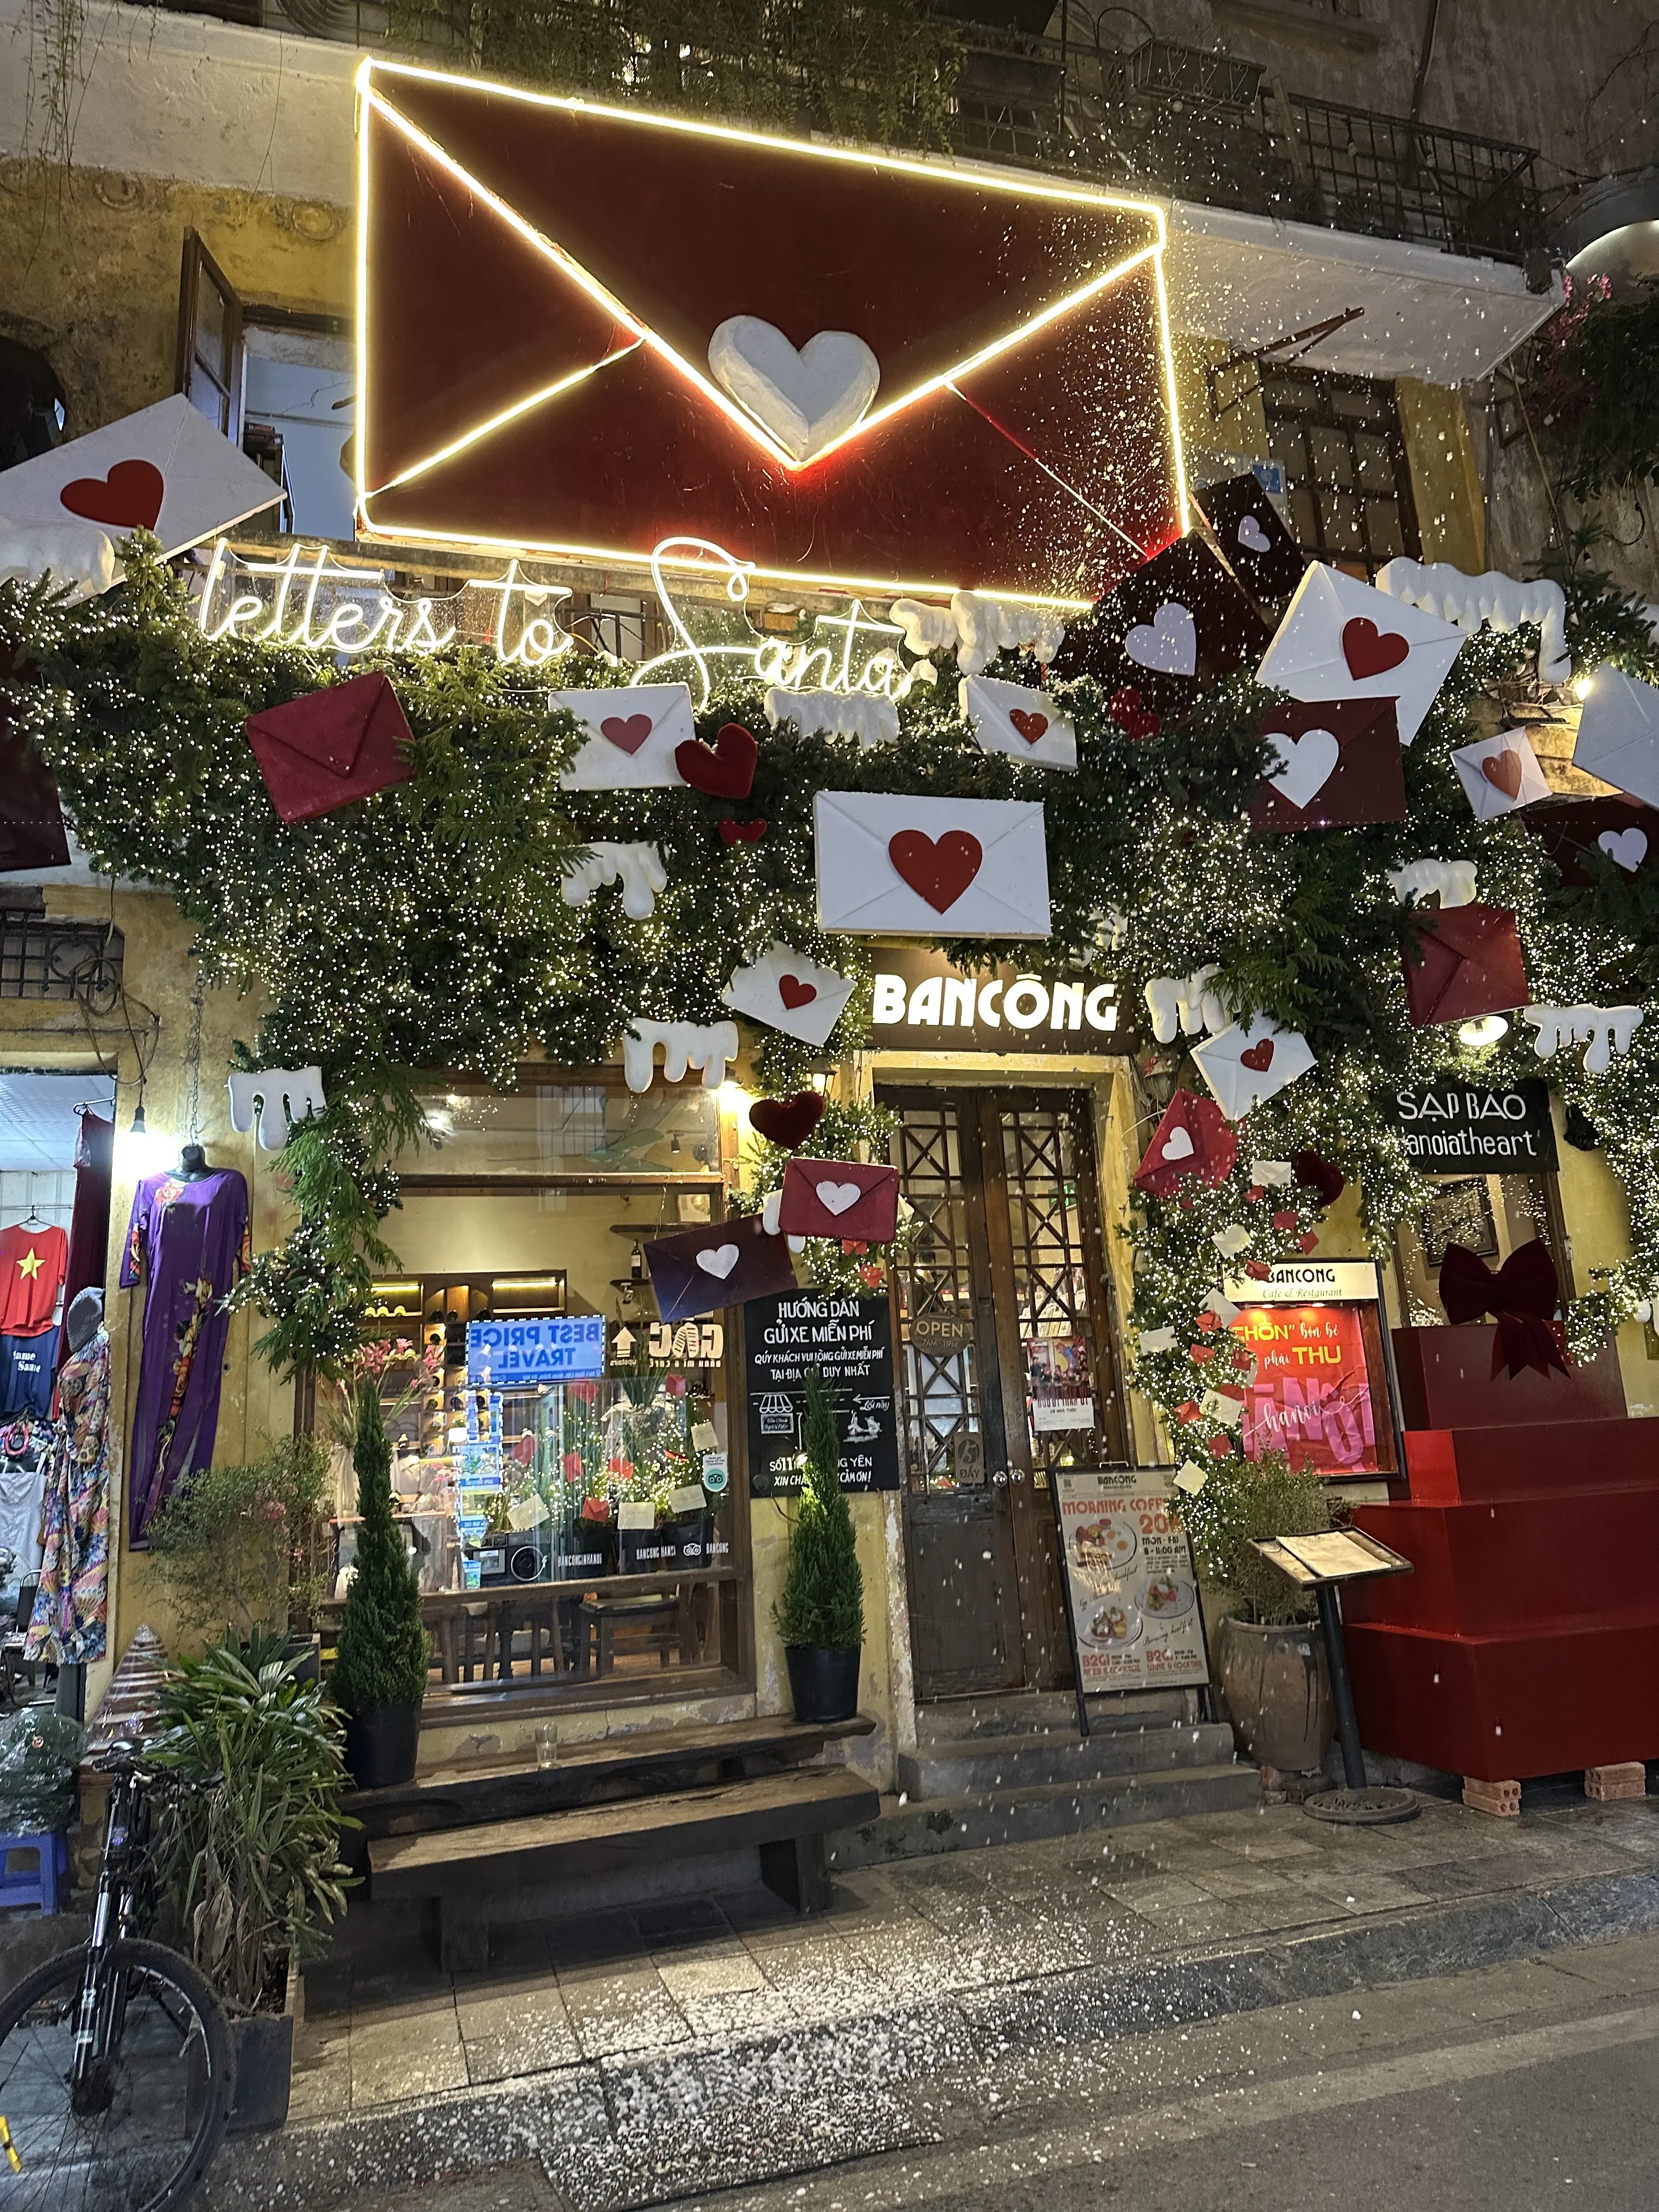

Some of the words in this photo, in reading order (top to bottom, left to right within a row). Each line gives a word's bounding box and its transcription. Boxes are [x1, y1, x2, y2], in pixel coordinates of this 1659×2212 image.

[199, 538, 455, 654] letters
[469, 558, 573, 666] to
[631, 536, 913, 712] Santa
[1466, 1092, 1526, 1120] BAO
[1296, 1288, 1343, 1299] Restaurant
[778, 1296, 828, 1318] HƯỚNG
[764, 1319, 788, 1344] GỬI
[790, 1327, 810, 1343] XE
[812, 1319, 847, 1343] MIỄN
[849, 1319, 875, 1341] PHÍ
[916, 1320, 963, 1339] OPEN
[773, 1350, 800, 1363] KHÁCH
[802, 1352, 813, 1362] VUI
[847, 1351, 856, 1360] XE
[856, 1345, 871, 1360] MIỄN
[872, 1346, 885, 1359] PHÍ
[1291, 1345, 1341, 1365] THU
[770, 1369, 785, 1382] TẠI
[785, 1368, 802, 1382] ĐỊA
[823, 1366, 841, 1378] DUY
[844, 1361, 871, 1376] NHẤT
[850, 1454, 872, 1468] YÊN
[774, 1475, 789, 1486] XIN
[790, 1475, 808, 1486] CH
[840, 1469, 855, 1483] CẢM
[1061, 1499, 1126, 1515] MORNING
[1142, 1536, 1161, 1545] MON
